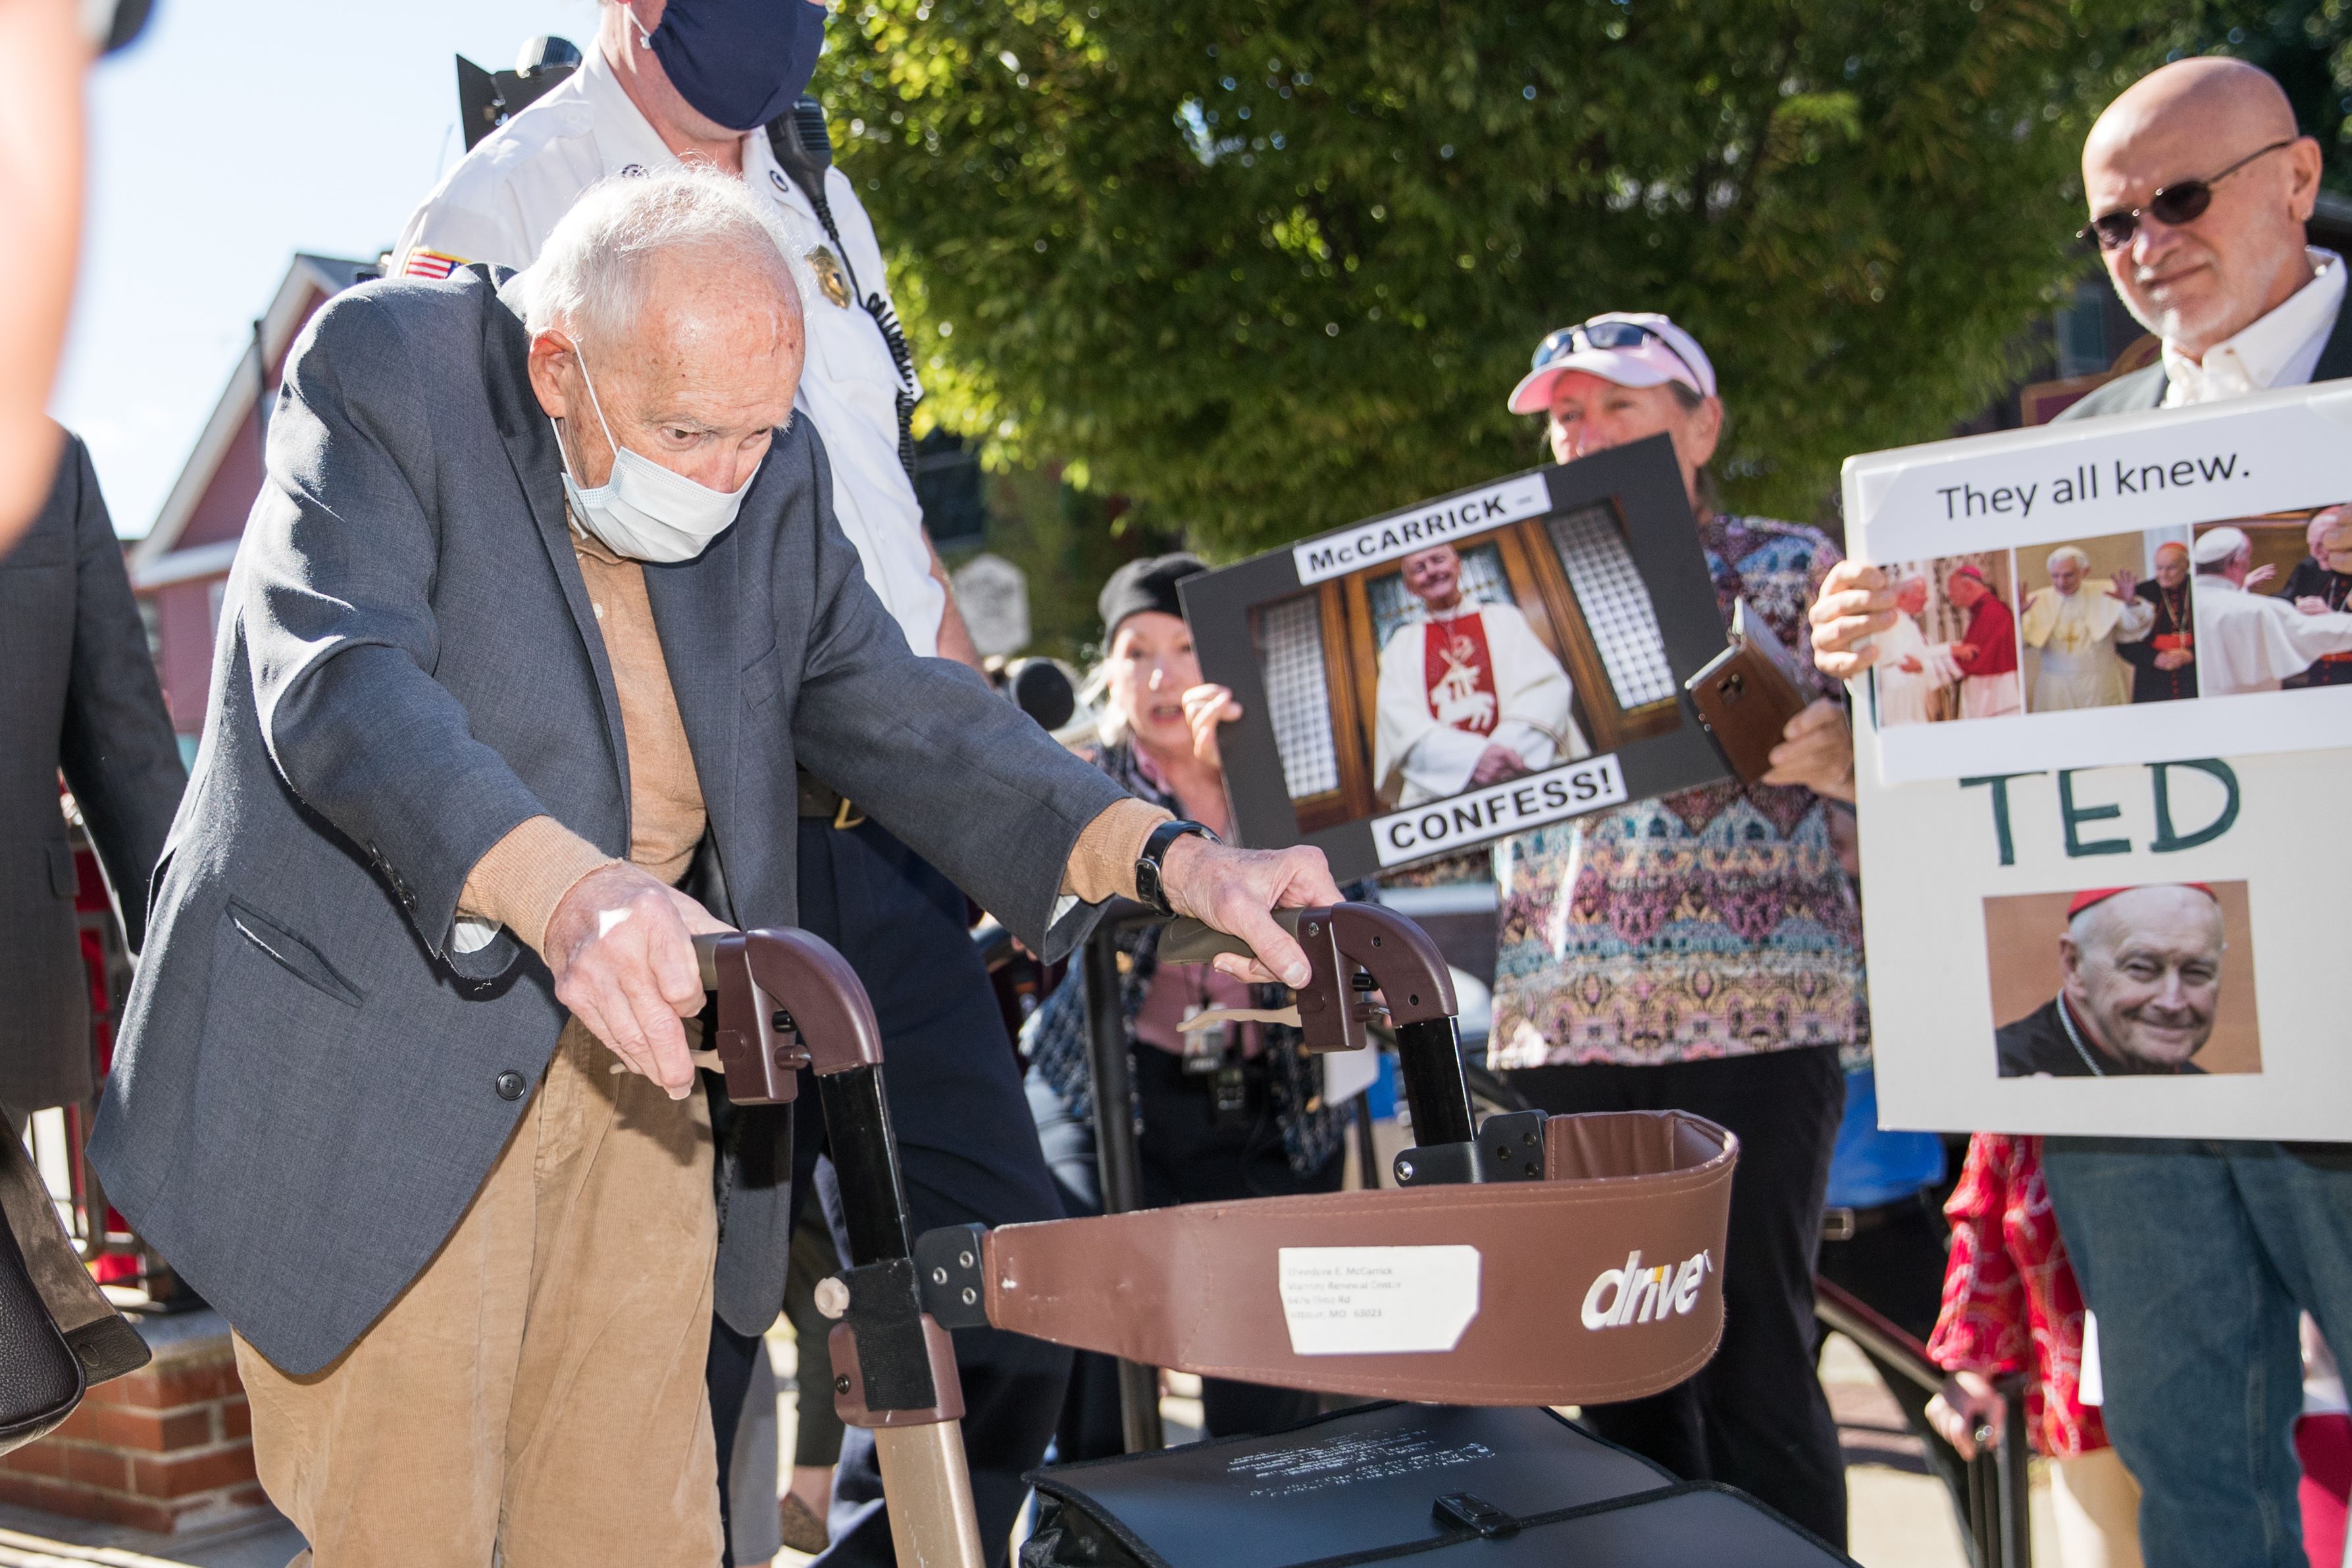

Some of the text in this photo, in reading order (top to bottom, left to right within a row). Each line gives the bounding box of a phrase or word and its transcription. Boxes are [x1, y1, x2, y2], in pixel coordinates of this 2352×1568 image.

[1938, 453, 2249, 519] They all knew.
[1310, 494, 1506, 573] McCARRICK
[1388, 769, 1611, 849] CONFESS!
[1960, 758, 2241, 866] TED
[1327, 1281, 1368, 1290] Renewal
[1338, 1295, 1350, 1303] Rd
[1346, 1267, 1393, 1275] McCarrick
[1581, 1250, 1706, 1330] drive
[1329, 1309, 1346, 1318] MO
[1354, 1308, 1383, 1317] 63023
